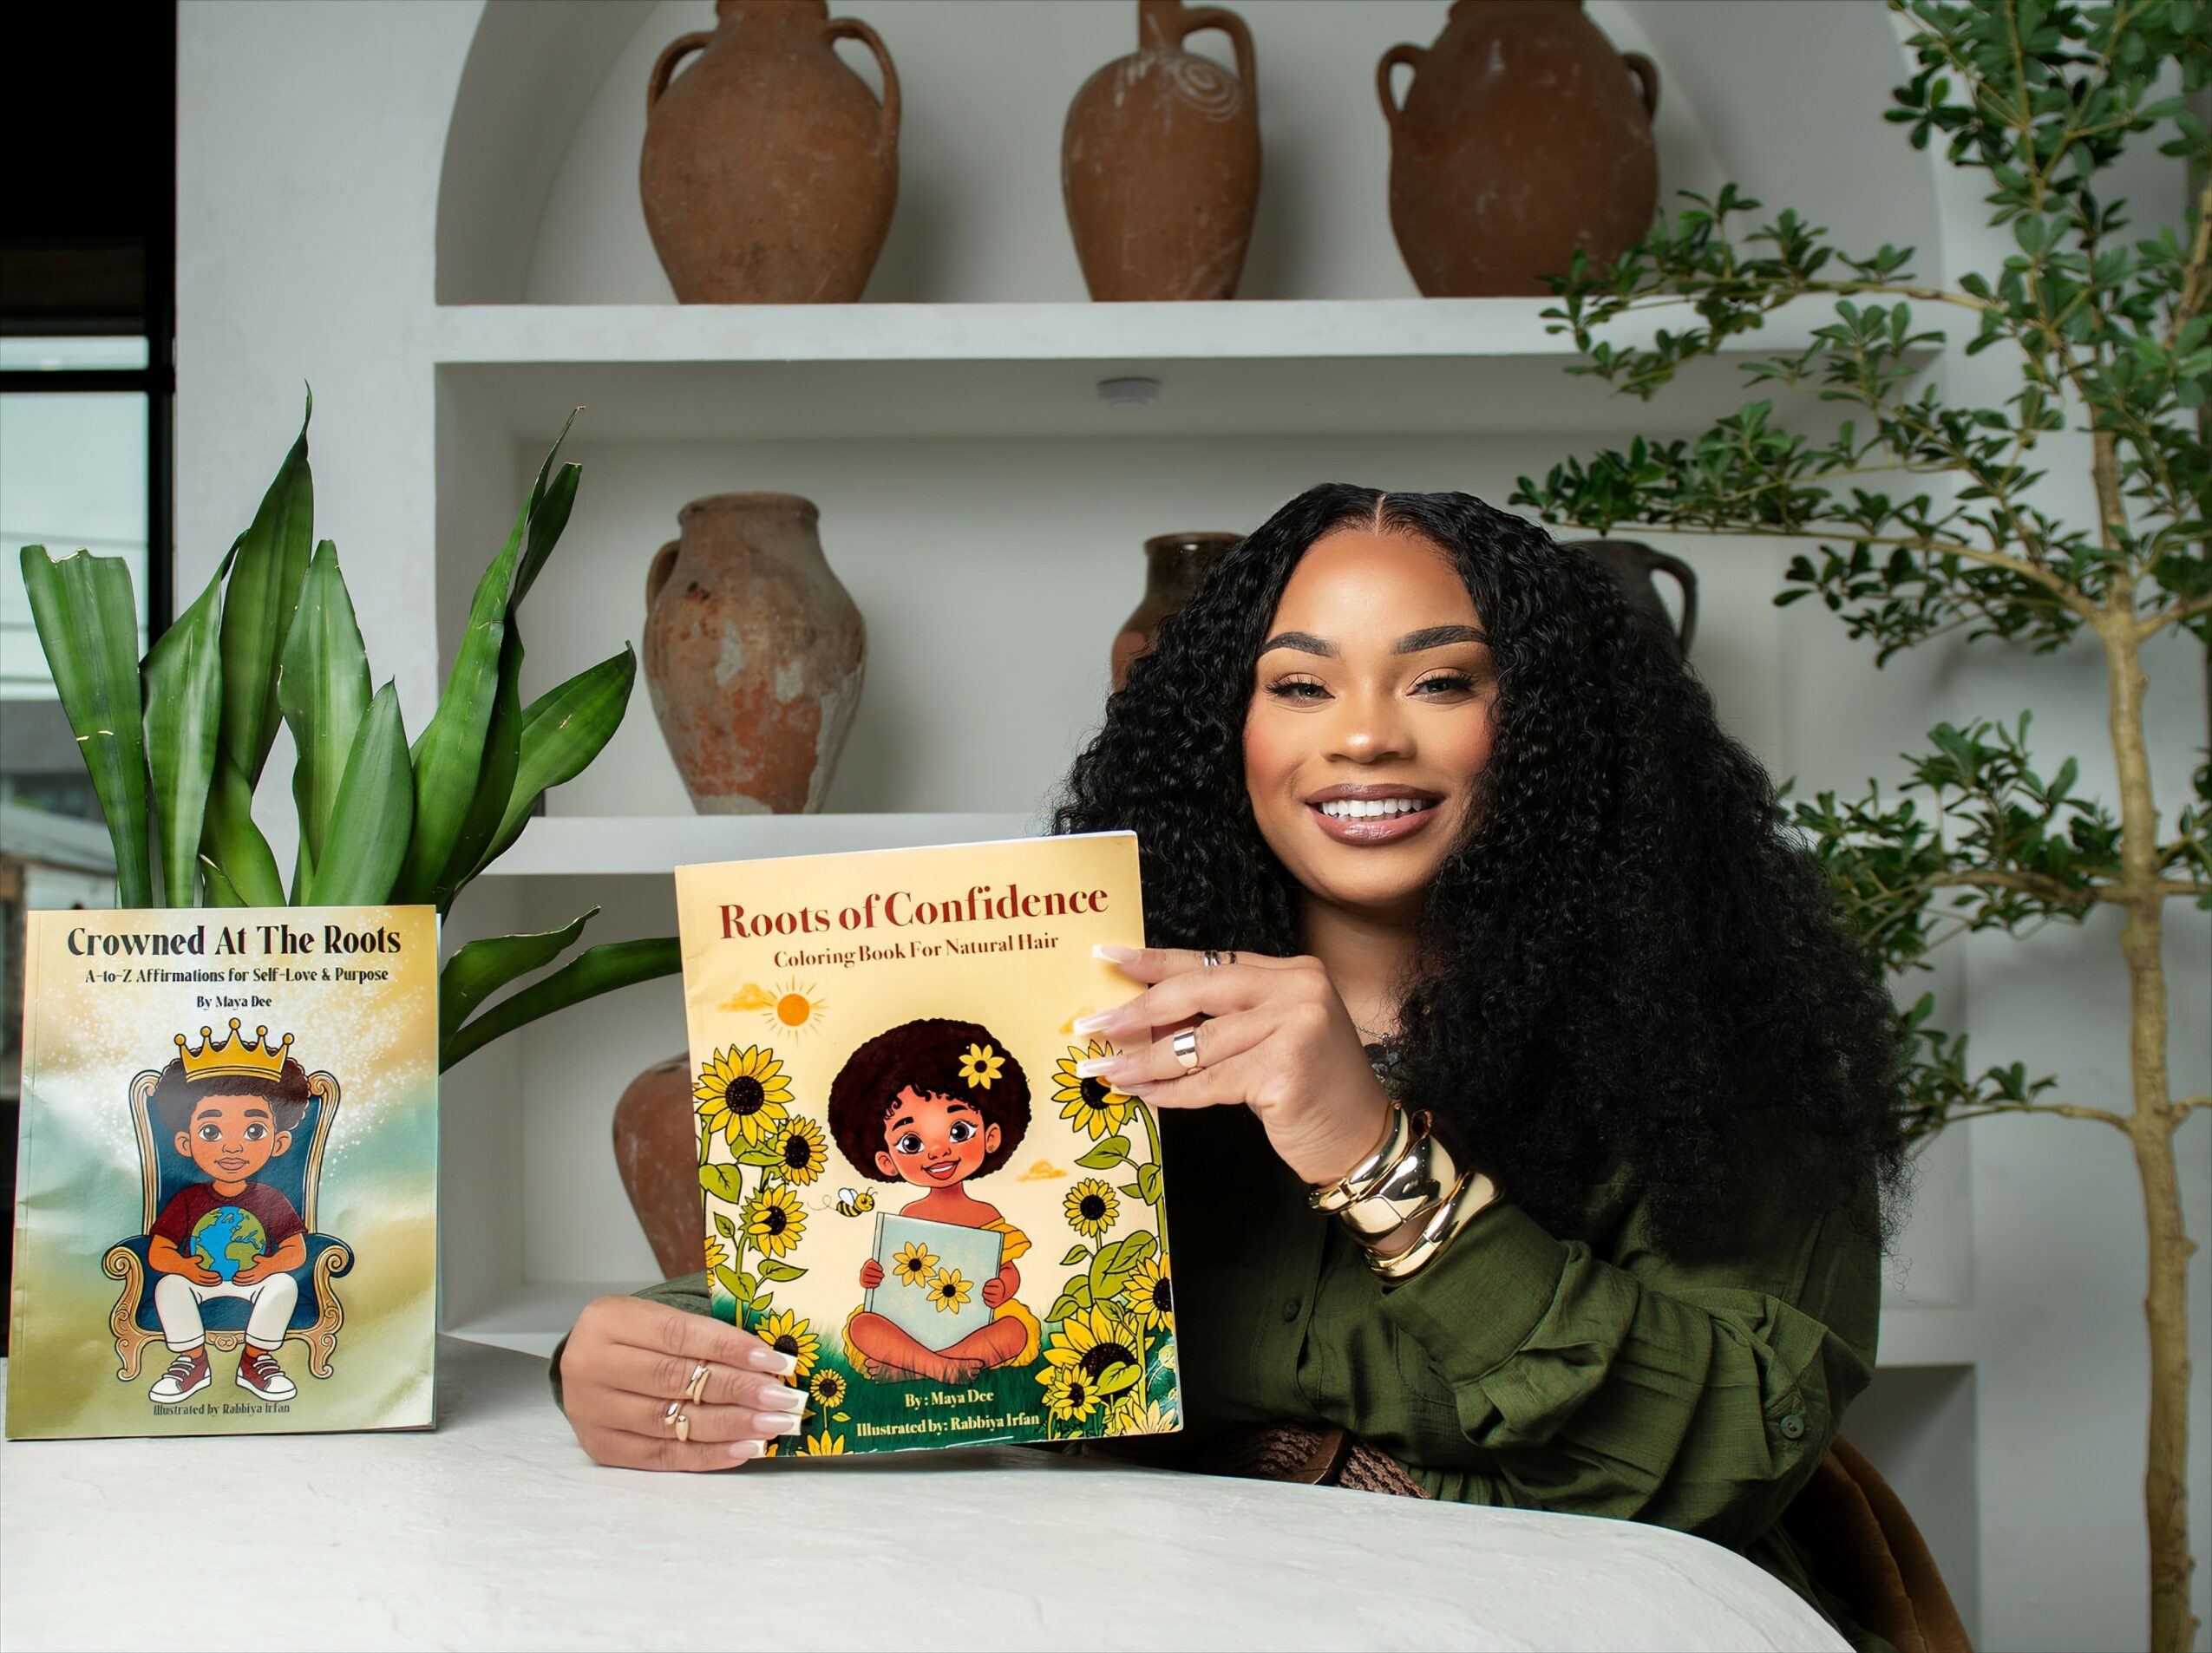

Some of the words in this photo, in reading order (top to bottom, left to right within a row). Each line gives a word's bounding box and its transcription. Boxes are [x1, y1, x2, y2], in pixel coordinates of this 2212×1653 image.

[717, 904, 831, 939] Roots
[839, 892, 880, 931] of
[884, 884, 1109, 927] Confidence
[68, 925, 205, 956] Crowned
[215, 925, 247, 955] At
[256, 924, 315, 955] The
[324, 925, 402, 954] Roots
[774, 948, 856, 969] Coloring
[859, 943, 906, 962] Book
[909, 940, 942, 958] For
[946, 934, 1013, 956] Natural
[1018, 931, 1058, 951] Hair
[85, 969, 132, 983] A-to-Z
[136, 968, 225, 983] Affirmations
[228, 967, 249, 982] for
[253, 967, 317, 982] Self-Love
[321, 968, 330, 981] &
[335, 967, 389, 984] Purpose
[197, 996, 213, 1010] By
[216, 996, 248, 1010] Maya
[251, 995, 272, 1007] Dee
[931, 1391, 965, 1408] Maya
[967, 1388, 995, 1403] Dee
[153, 1403, 205, 1416] Illustrated
[207, 1403, 219, 1417] by
[222, 1403, 262, 1416] Rabbiya
[265, 1402, 290, 1414] Irfan
[856, 1419, 926, 1437] Illustrated
[928, 1418, 948, 1435] by:
[950, 1415, 1005, 1434] Rabbiya
[1006, 1412, 1040, 1428] Irfan
